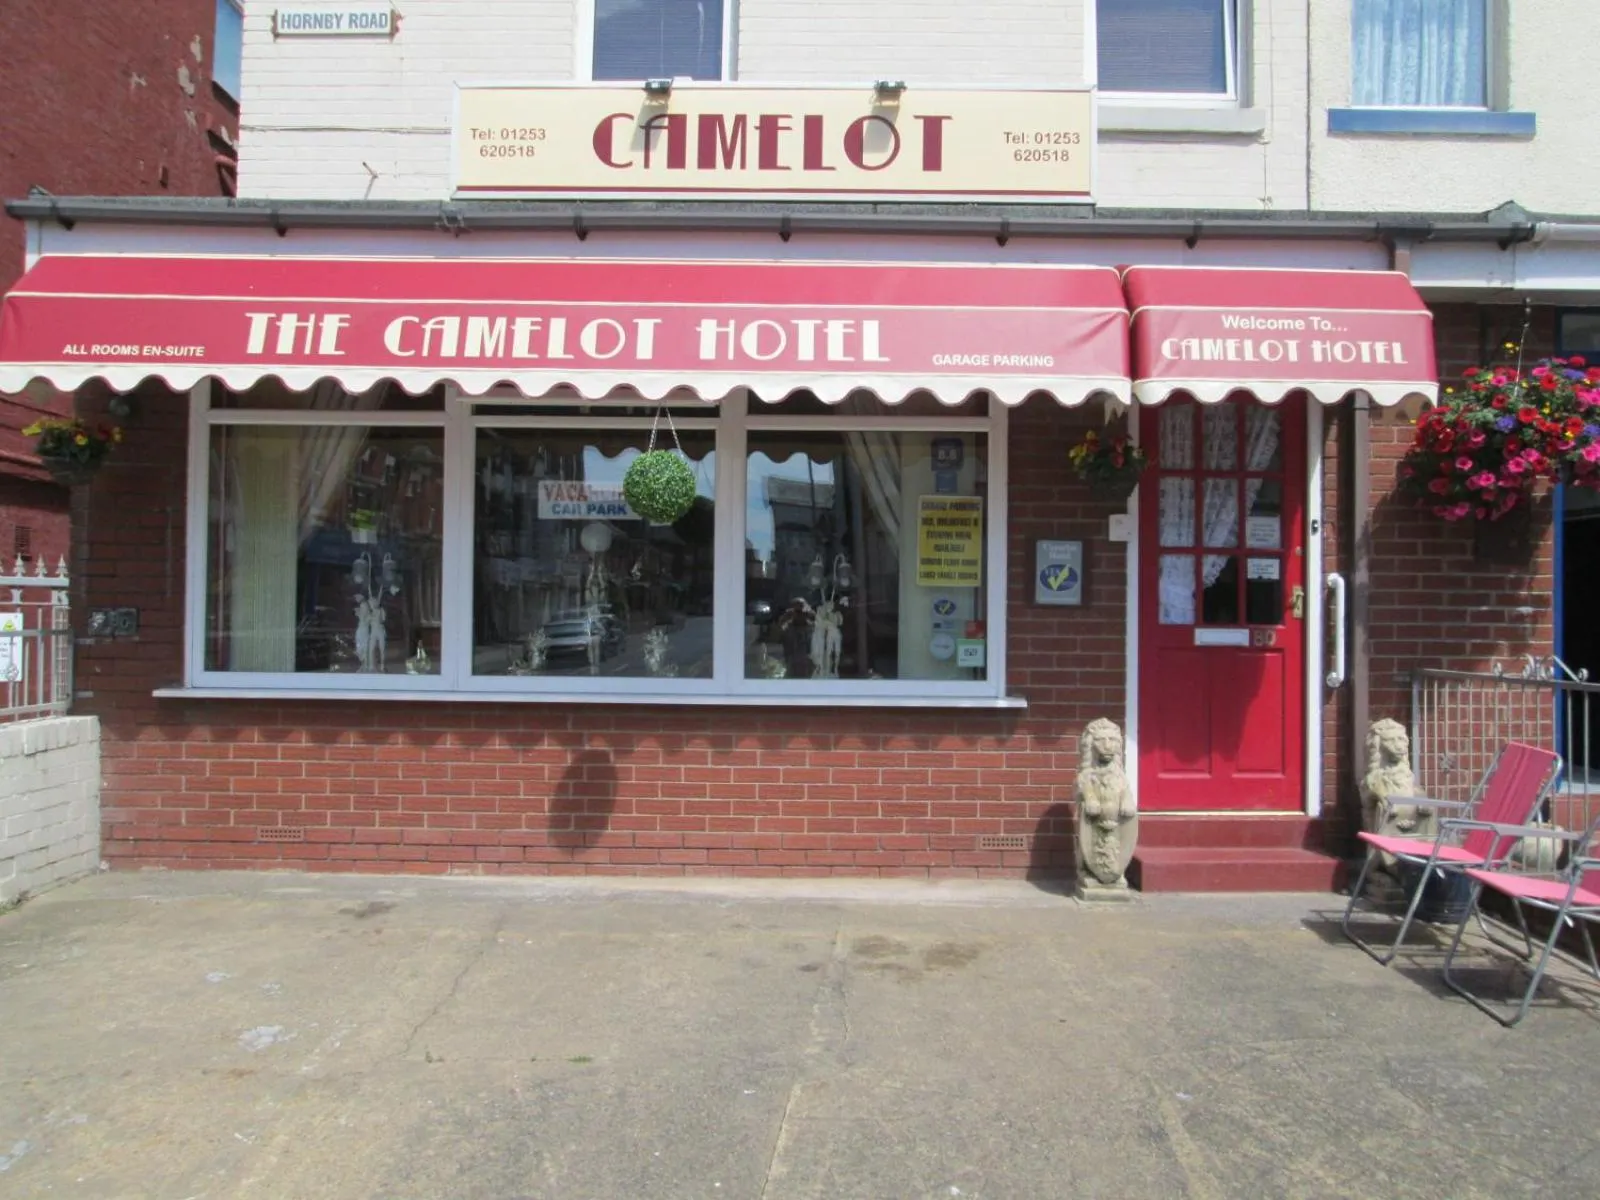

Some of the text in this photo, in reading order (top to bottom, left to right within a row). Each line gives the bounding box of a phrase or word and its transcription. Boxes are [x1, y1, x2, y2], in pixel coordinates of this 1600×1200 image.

[281, 12, 389, 29] HORNBY ROAD
[471, 128, 546, 141] Tel: 01253
[1003, 132, 1081, 145] Tel: 01253
[593, 112, 953, 172] CAMELOT
[479, 145, 535, 158] 620518
[1013, 149, 1070, 162] 620518
[1221, 314, 1348, 332] Welcome To...
[245, 312, 891, 362] THE CAMELOT HOTEL
[63, 344, 205, 357] ALL ROOMS EN-SUITE
[1161, 338, 1408, 364] CAMELOT HOTEL
[932, 353, 1055, 367] GARAGE PARKING
[587, 503, 627, 516] PARK
